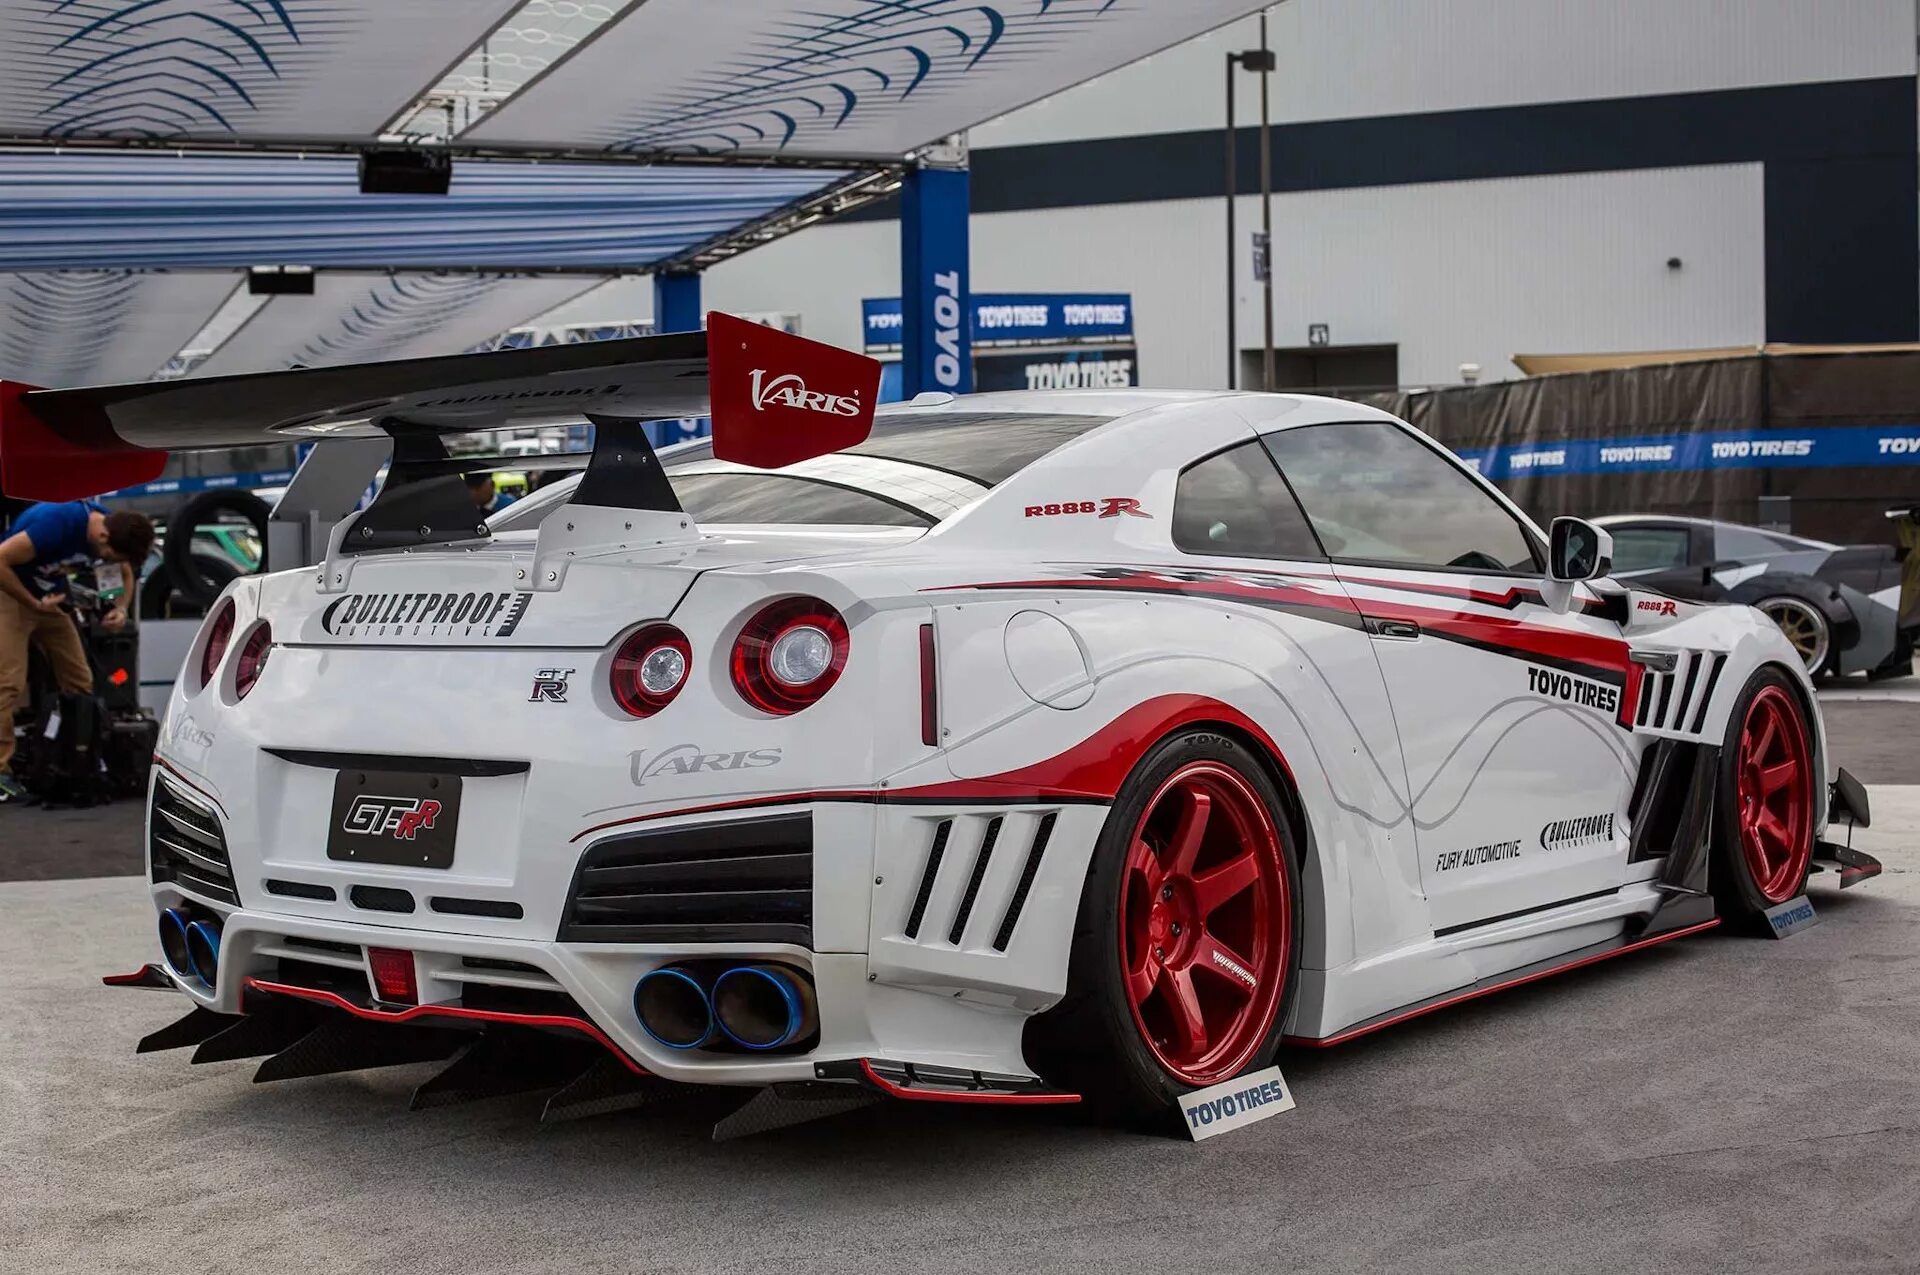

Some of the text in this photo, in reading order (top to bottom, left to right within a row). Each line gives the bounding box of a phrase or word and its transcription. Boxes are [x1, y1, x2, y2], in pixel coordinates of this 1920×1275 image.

[934, 270, 960, 387] TOYO
[1025, 359, 1131, 390] TOYO TIRES
[748, 368, 860, 417] VARIS
[1712, 440, 1812, 458] TOYO TIRES
[340, 592, 511, 624] BULLETPROOF
[335, 625, 491, 636] AUTOMOTIVE
[1528, 667, 1617, 713] TOYO TIRES
[627, 744, 782, 787] VARIS
[1549, 814, 1608, 842] BULLETPROOF
[1436, 850, 1463, 872] FURY
[1462, 840, 1521, 868] AUTOMOTIVE
[1187, 1080, 1283, 1128] TOYO TIRES
